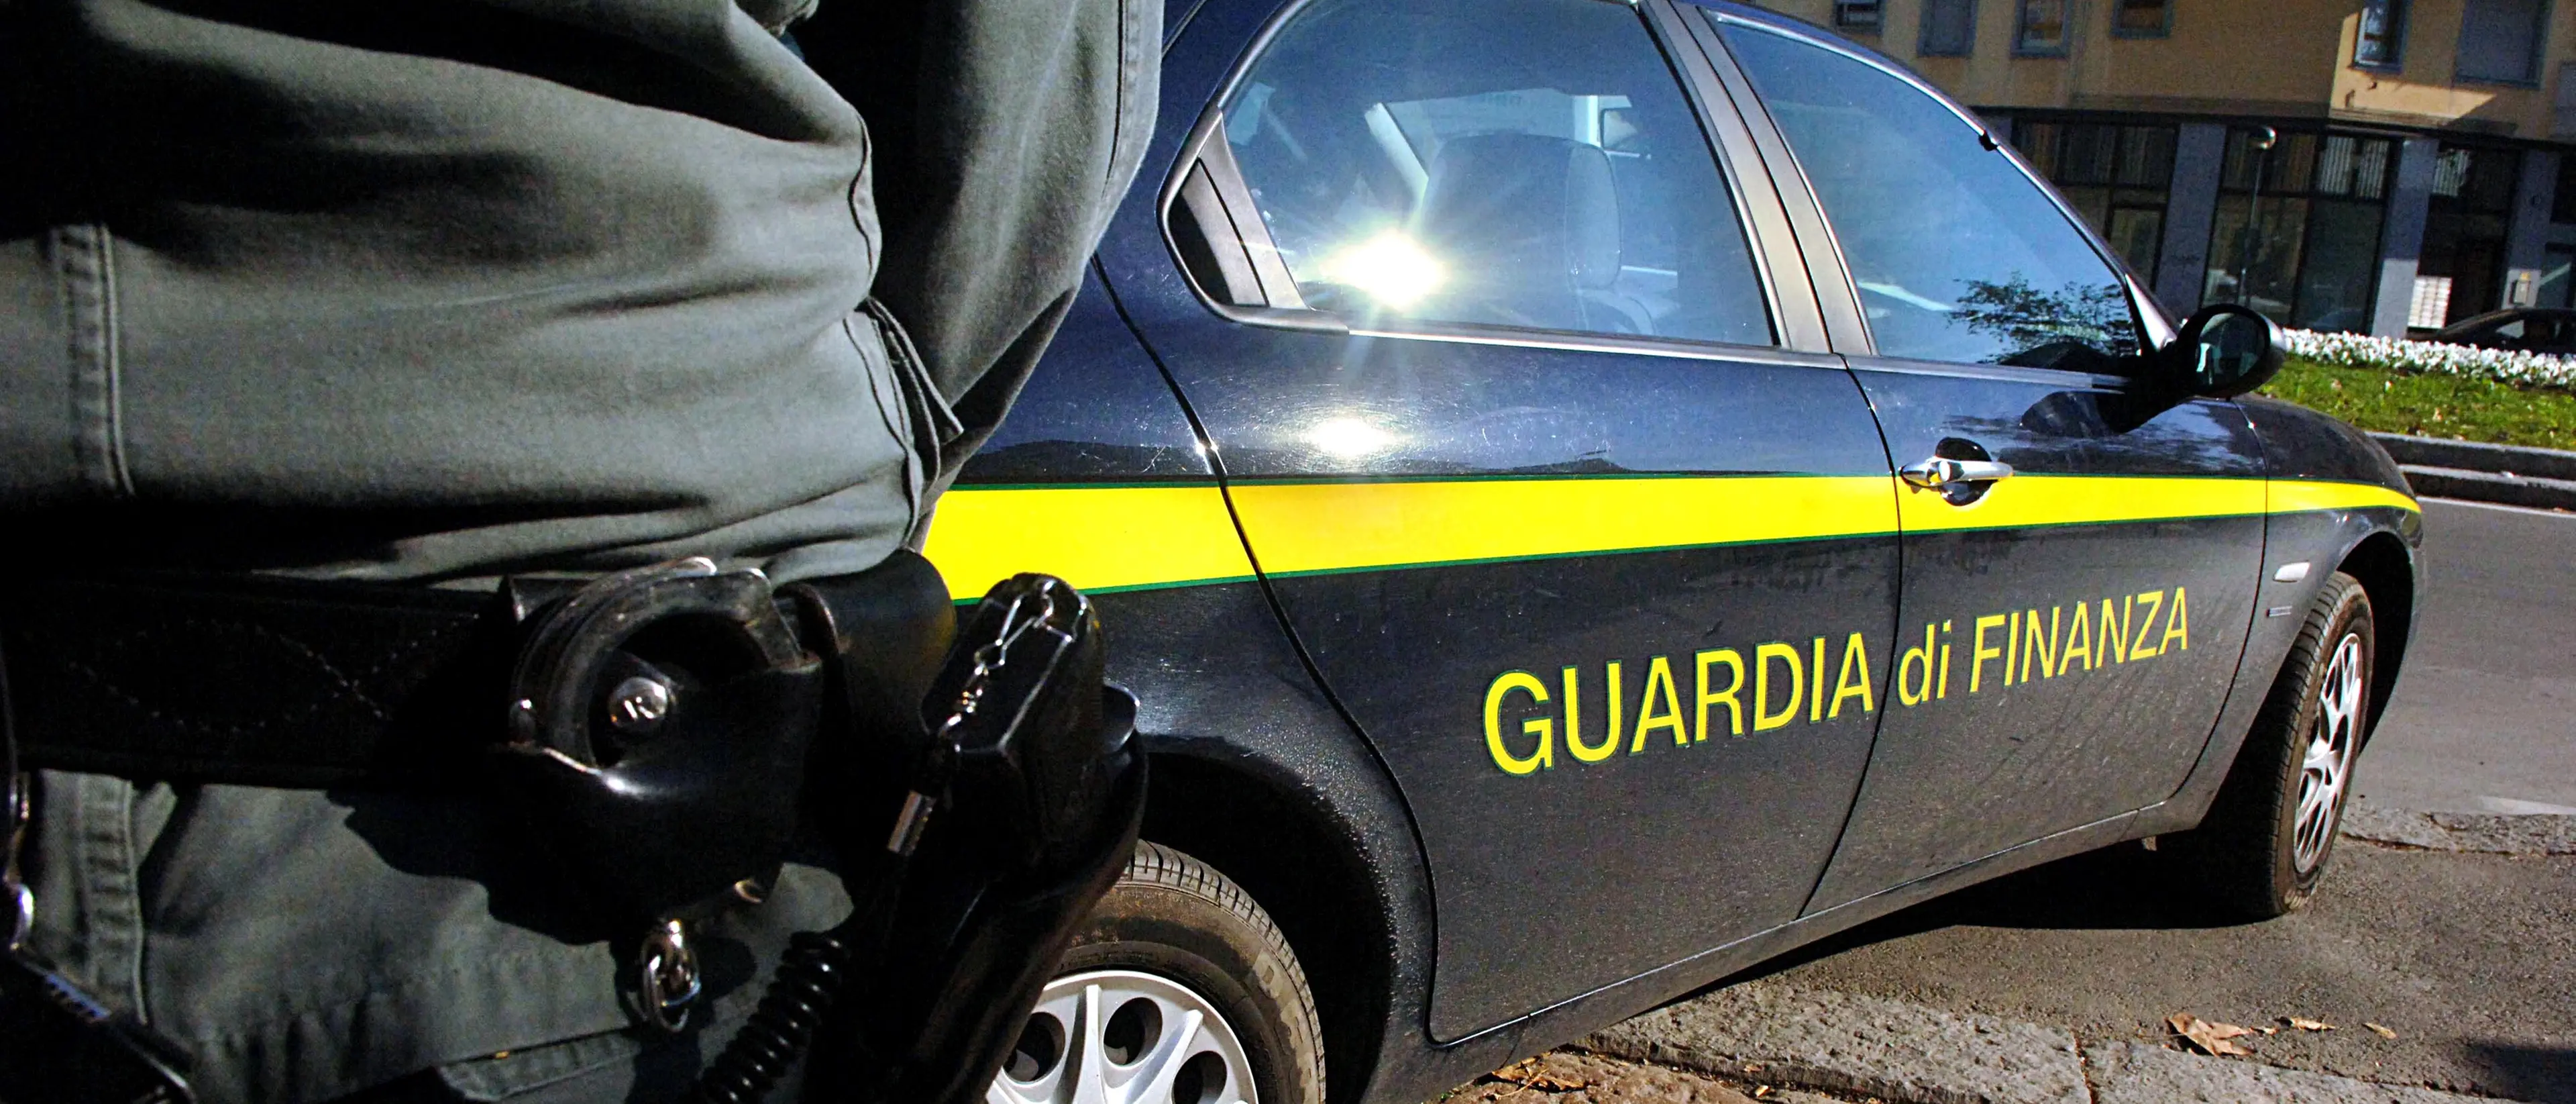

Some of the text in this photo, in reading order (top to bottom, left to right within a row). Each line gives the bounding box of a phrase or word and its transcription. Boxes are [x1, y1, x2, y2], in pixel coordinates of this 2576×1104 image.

[1483, 587, 2190, 777] GUARDIA di FINANZA
